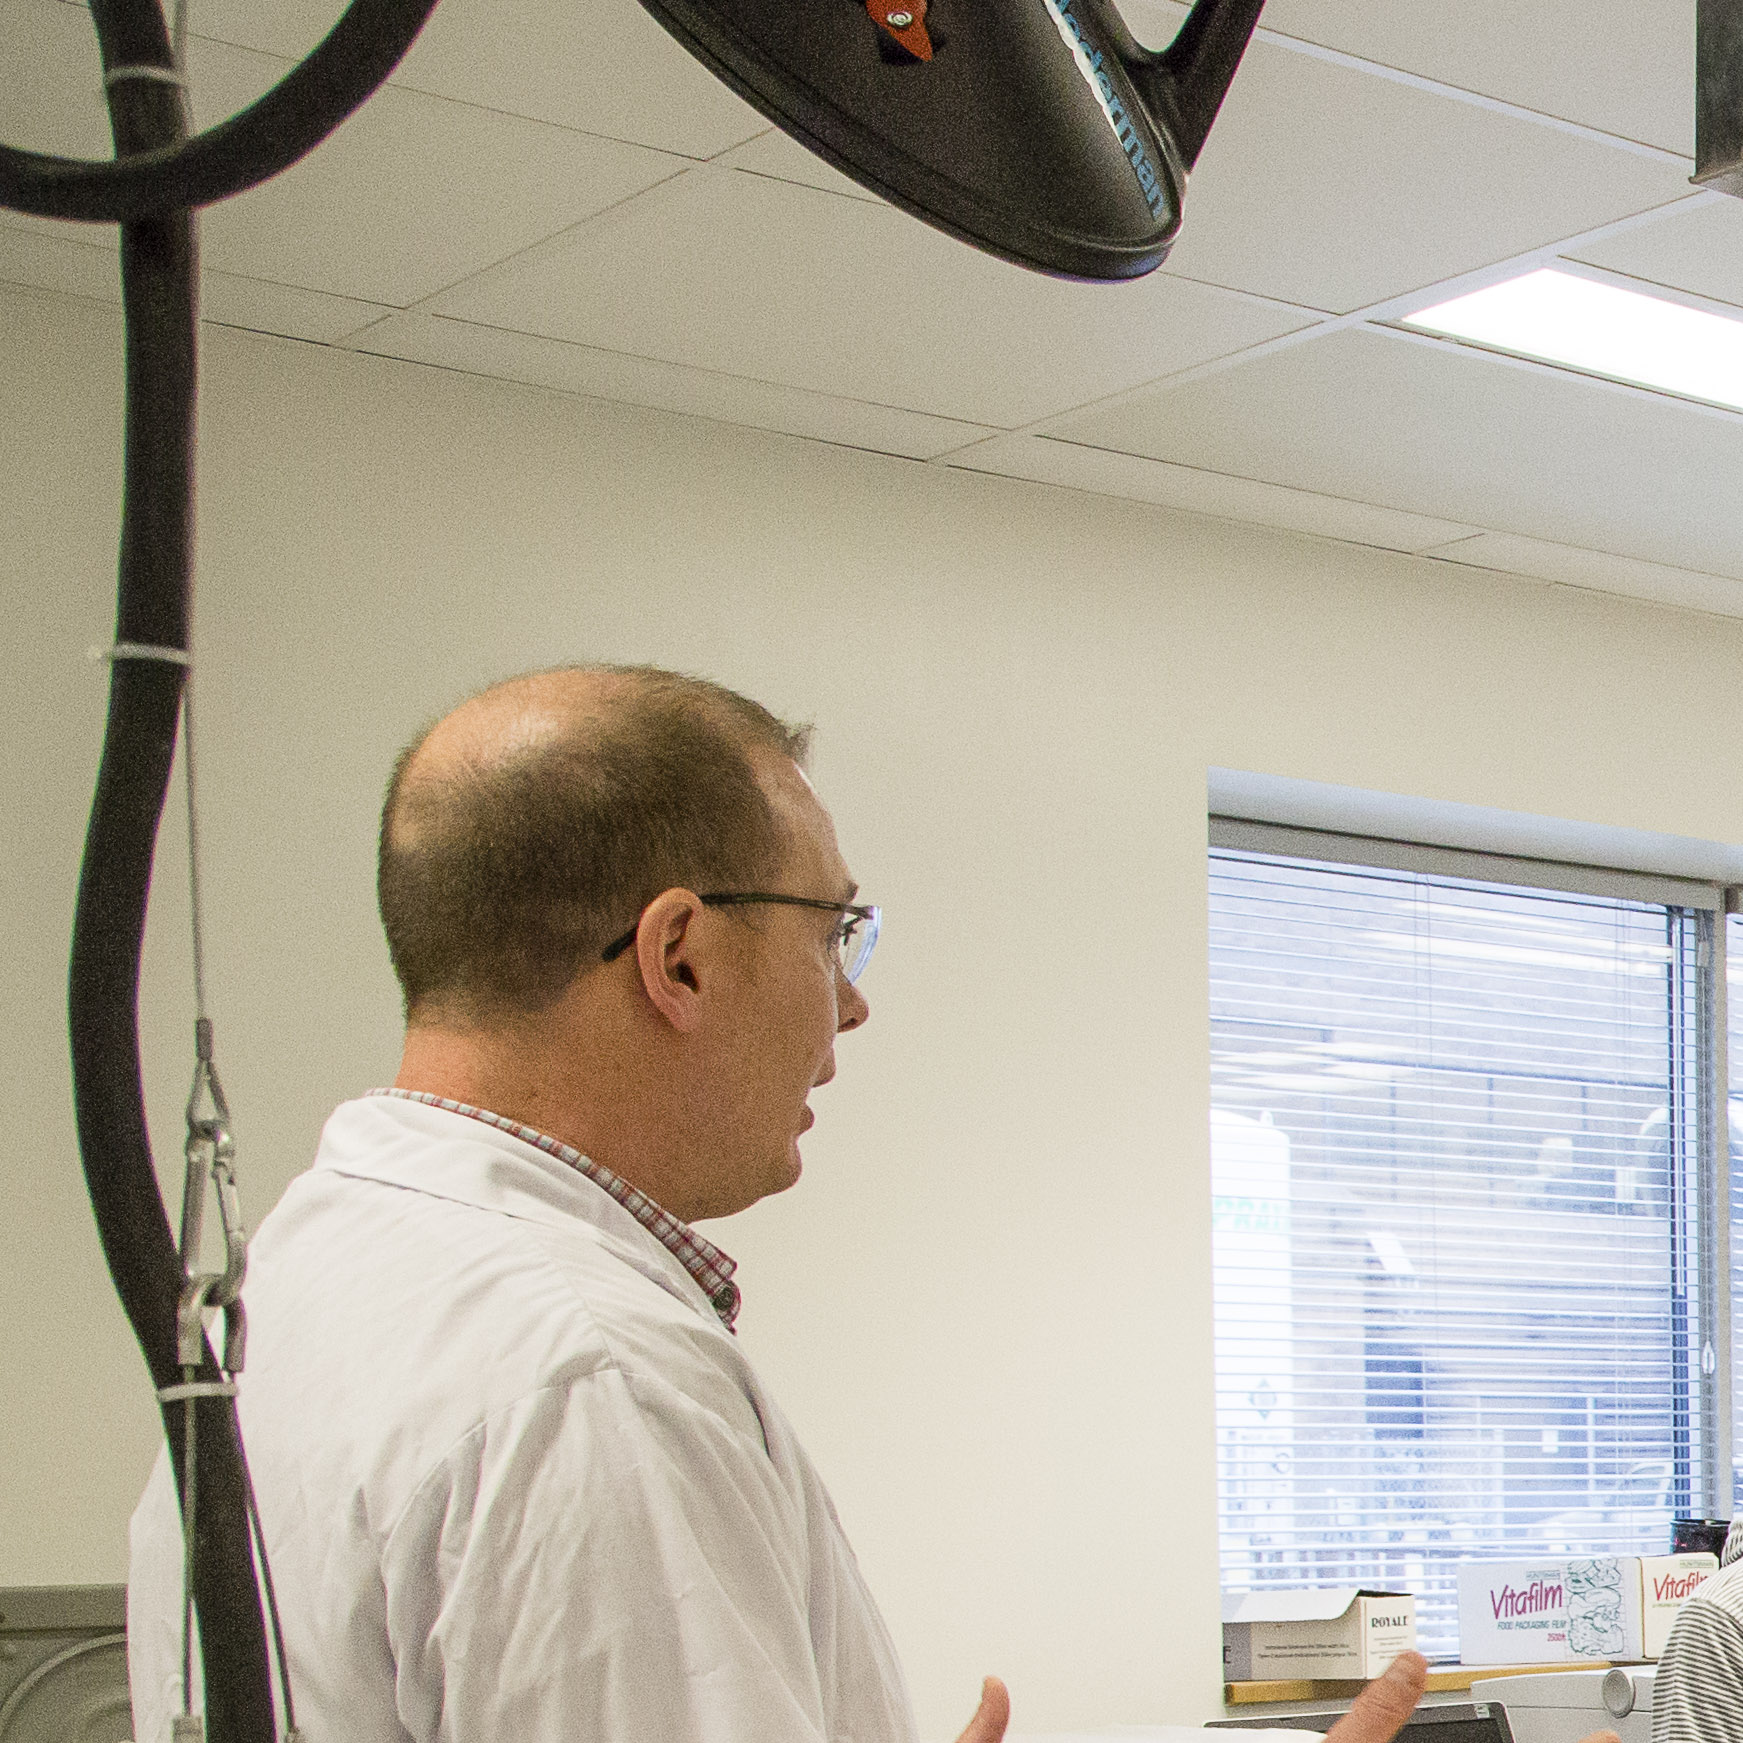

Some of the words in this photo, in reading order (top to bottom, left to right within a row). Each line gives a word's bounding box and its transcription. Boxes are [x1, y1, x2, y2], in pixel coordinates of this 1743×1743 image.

[1490, 1579, 1563, 1620] Vitafilm
[1371, 1615, 1409, 1628] ROYALE
[1498, 1620, 1513, 1630] FOOD
[1515, 1619, 1549, 1630] PACKAGING
[1551, 1620, 1567, 1629] FILM
